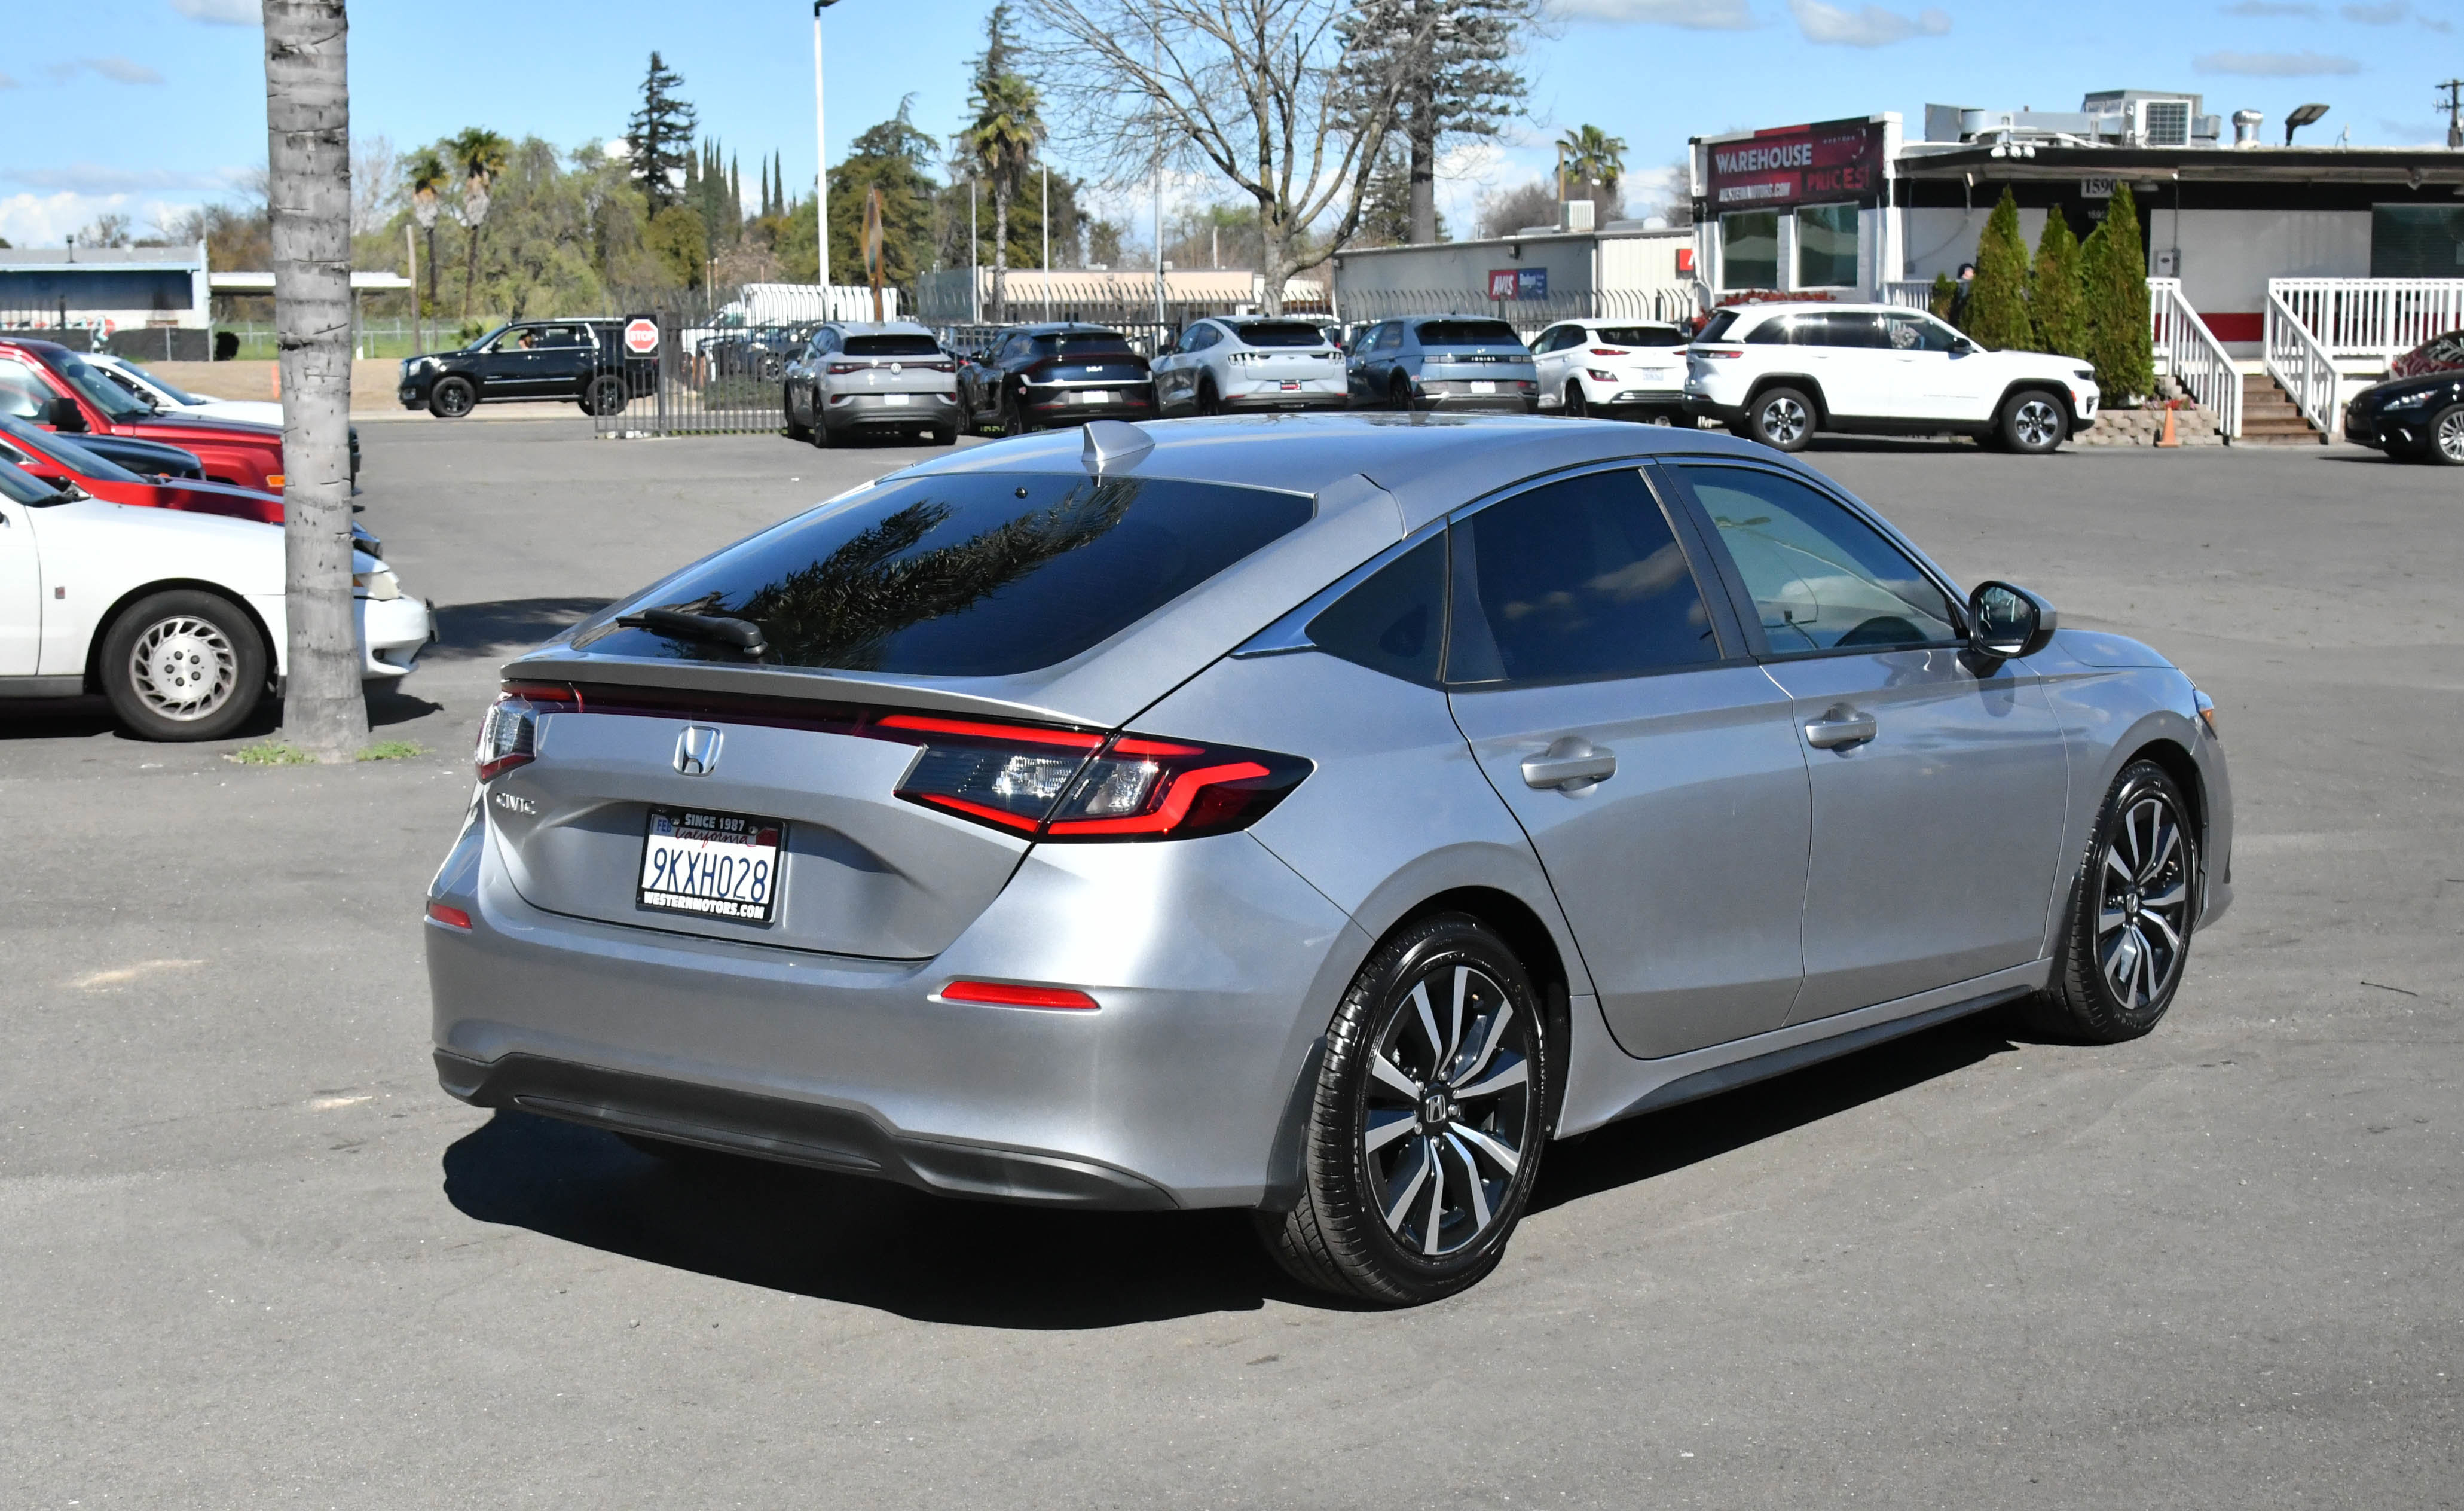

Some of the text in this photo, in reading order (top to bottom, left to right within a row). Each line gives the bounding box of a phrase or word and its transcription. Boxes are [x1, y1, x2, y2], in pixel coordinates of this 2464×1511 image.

[1715, 143, 1813, 175] WAREHOUSE
[1492, 274, 1514, 296] AVIS
[629, 330, 655, 342] STOP
[496, 792, 536, 815] CIVIC
[684, 813, 745, 832] SINCE 1987
[650, 847, 768, 903] 9KXH028
[644, 890, 765, 920] WESTERNMOTORS.COM
